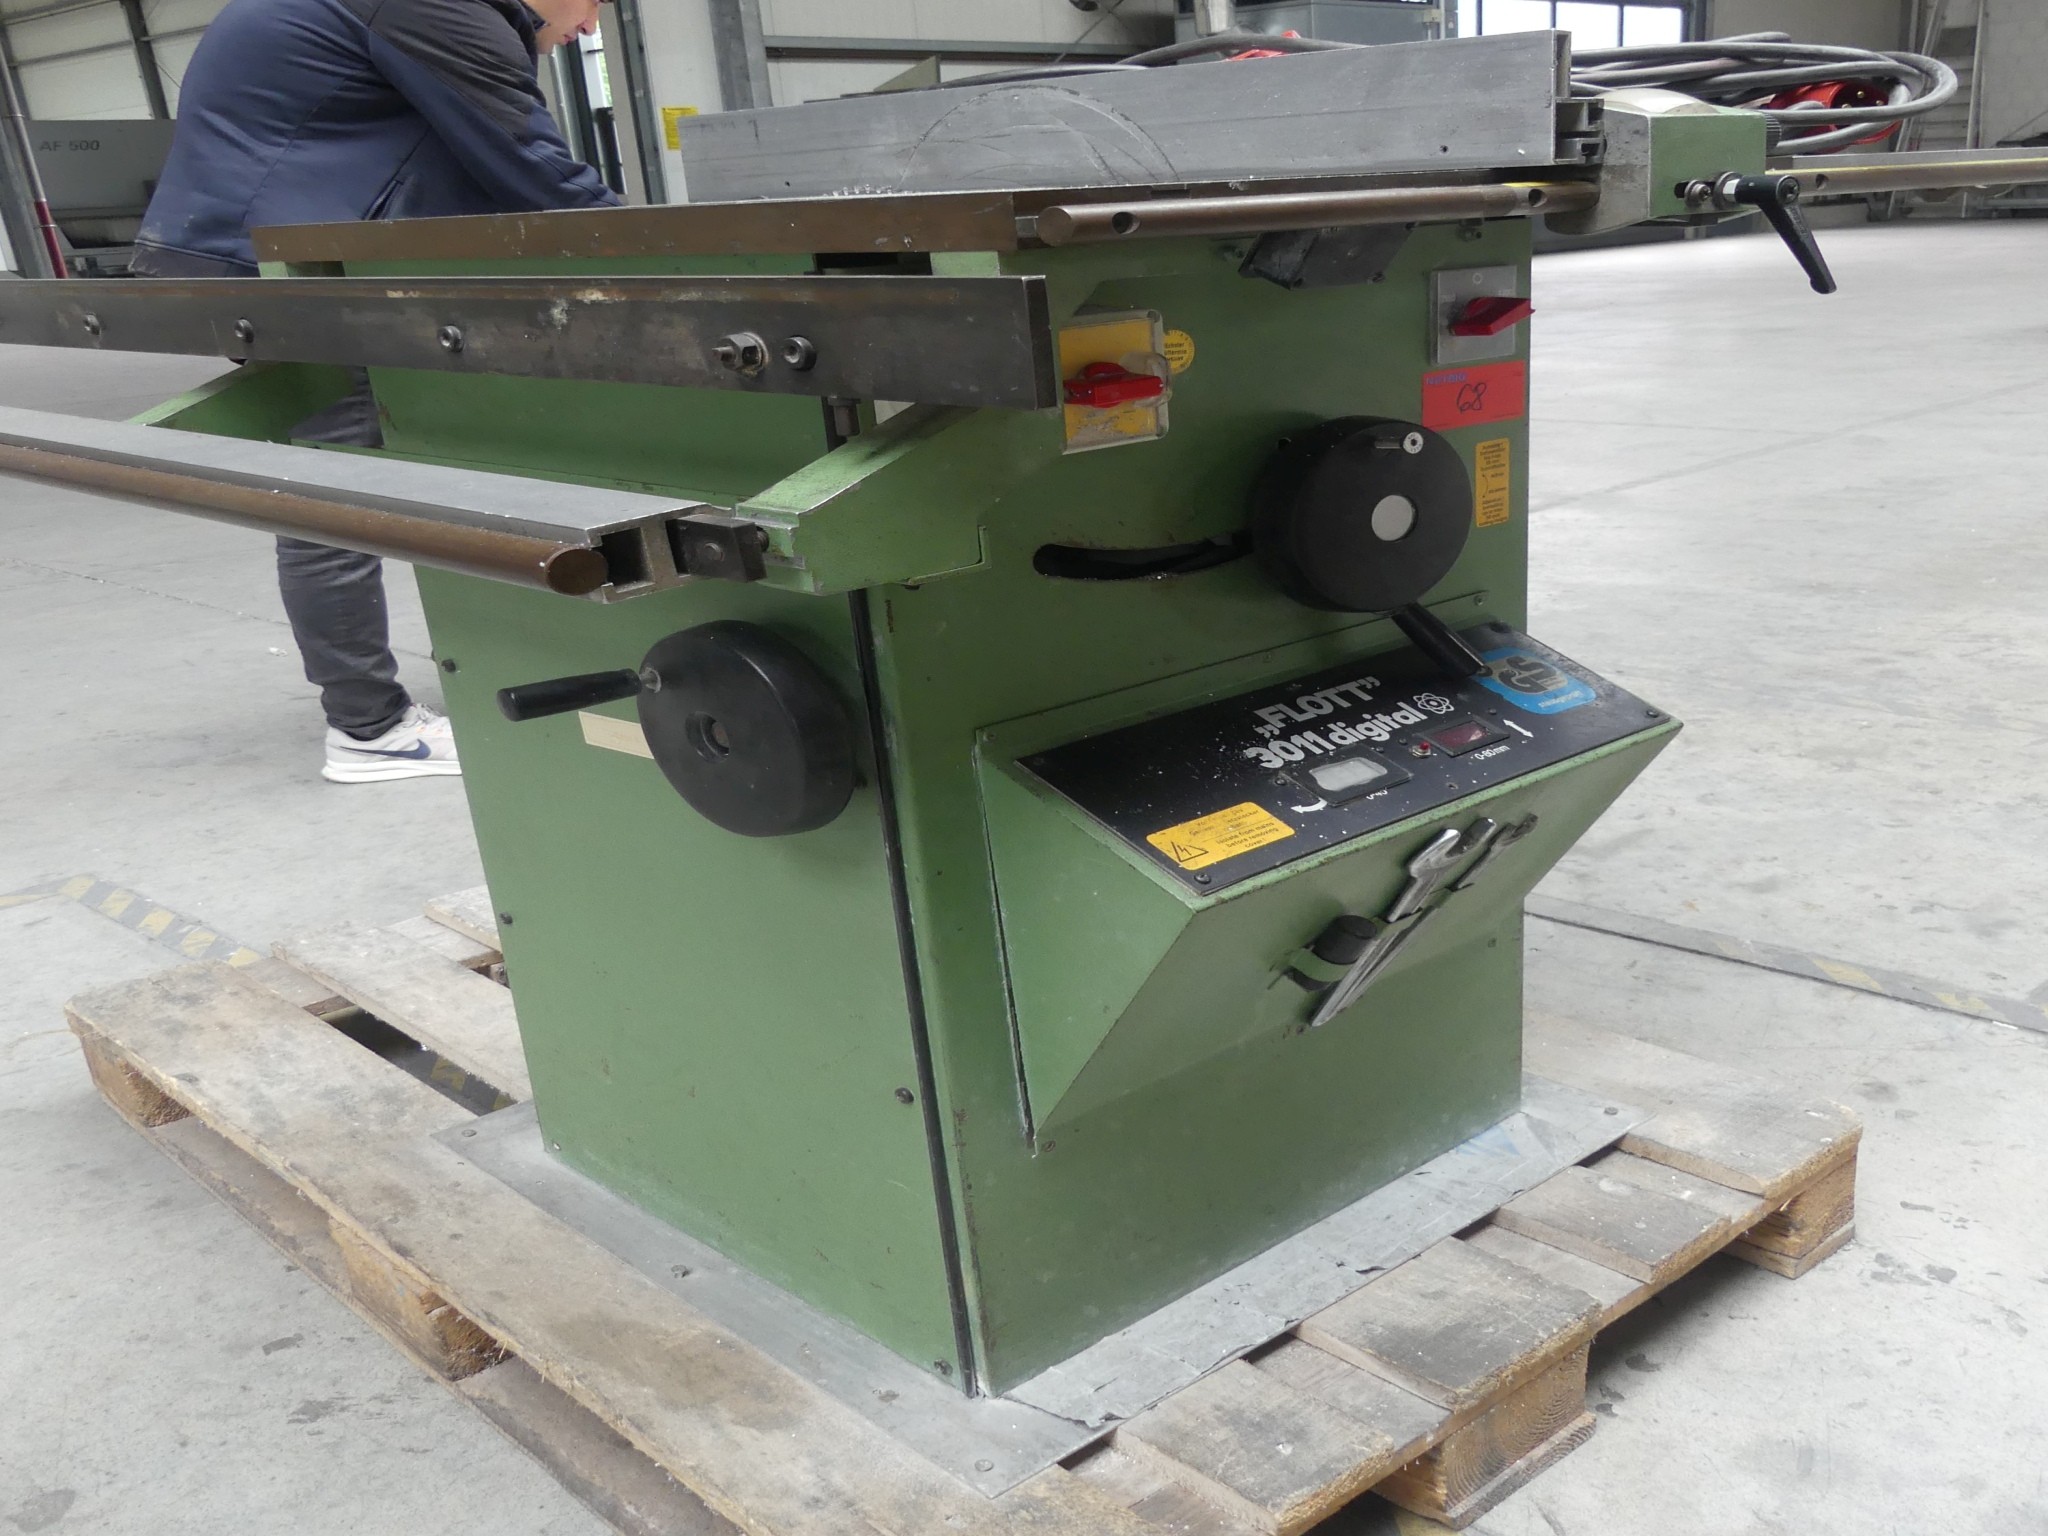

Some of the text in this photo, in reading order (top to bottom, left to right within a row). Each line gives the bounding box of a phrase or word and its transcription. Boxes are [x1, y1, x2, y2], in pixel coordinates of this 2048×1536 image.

[40, 140, 100, 151] AF 500
[1456, 382, 1487, 414] 68
[1243, 701, 1428, 769] 3011 digital
